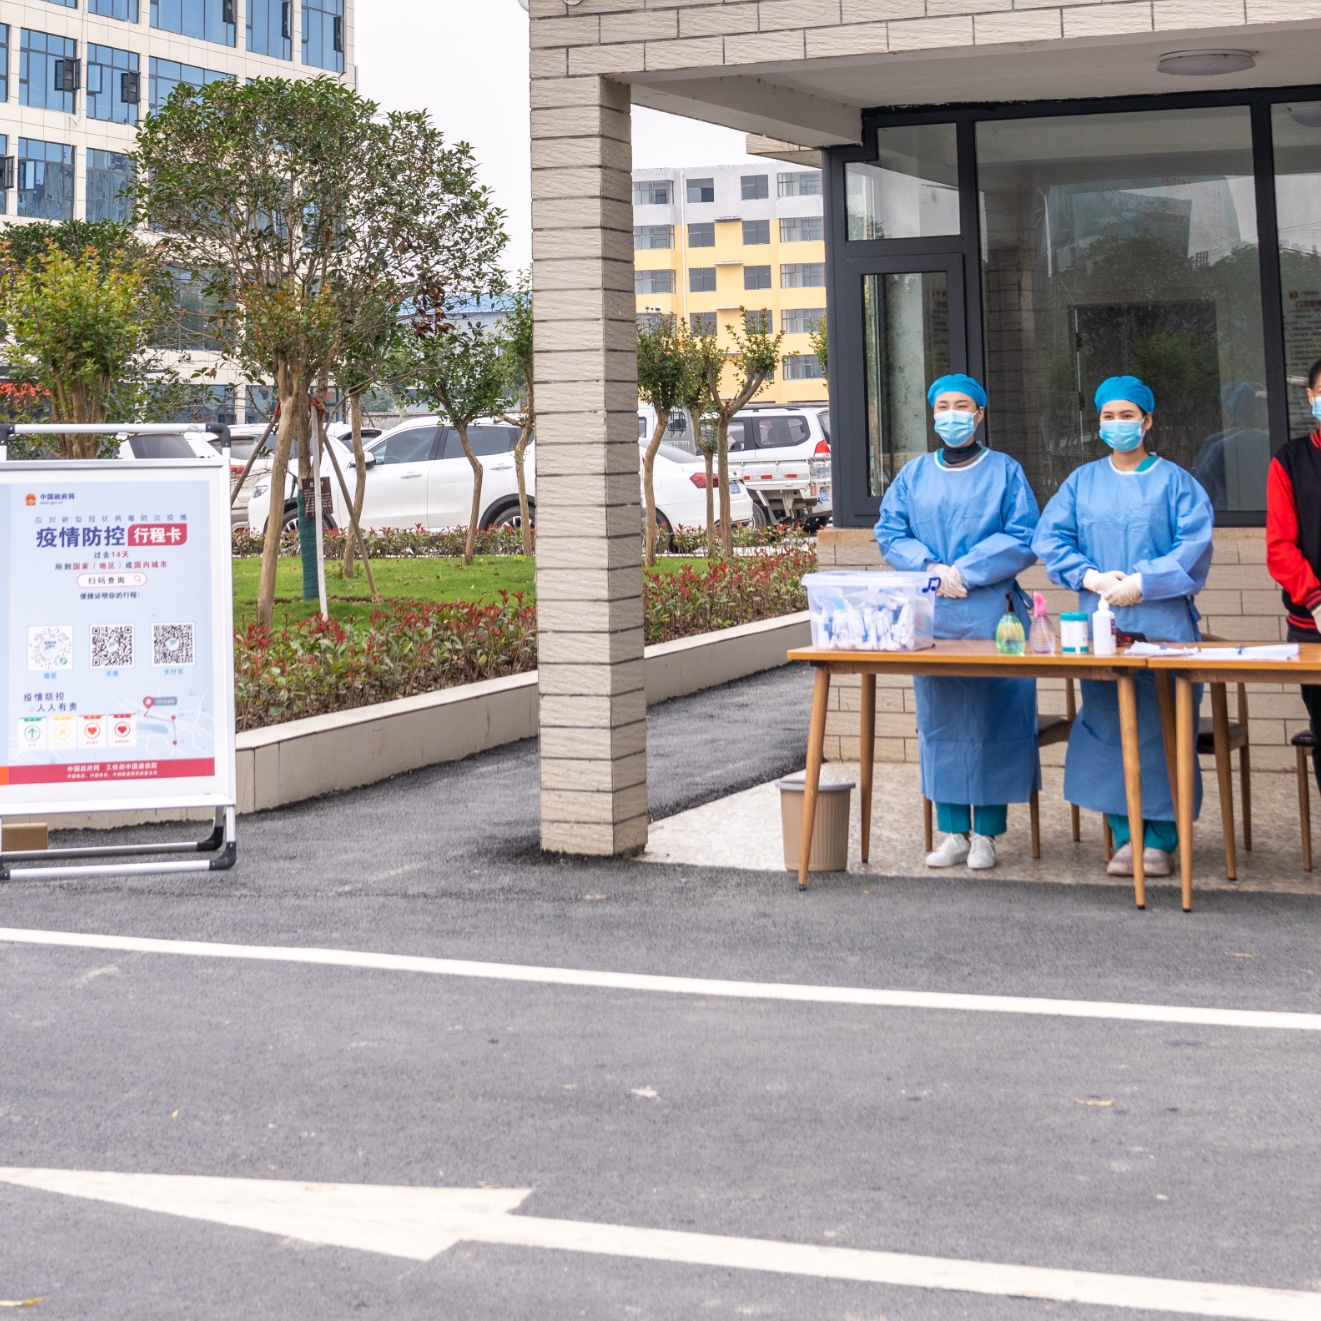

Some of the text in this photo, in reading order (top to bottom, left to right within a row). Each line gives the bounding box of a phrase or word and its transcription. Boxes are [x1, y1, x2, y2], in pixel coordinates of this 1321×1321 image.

[35, 514, 187, 524] 应对新型冠状病毒肺炎疫情
[36, 526, 182, 548] 疫情防控 行程卡
[94, 550, 129, 559] 过去14天
[88, 575, 125, 585] 扫码查询
[23, 691, 65, 702] 疫情防控
[37, 702, 77, 712] 人人有责
